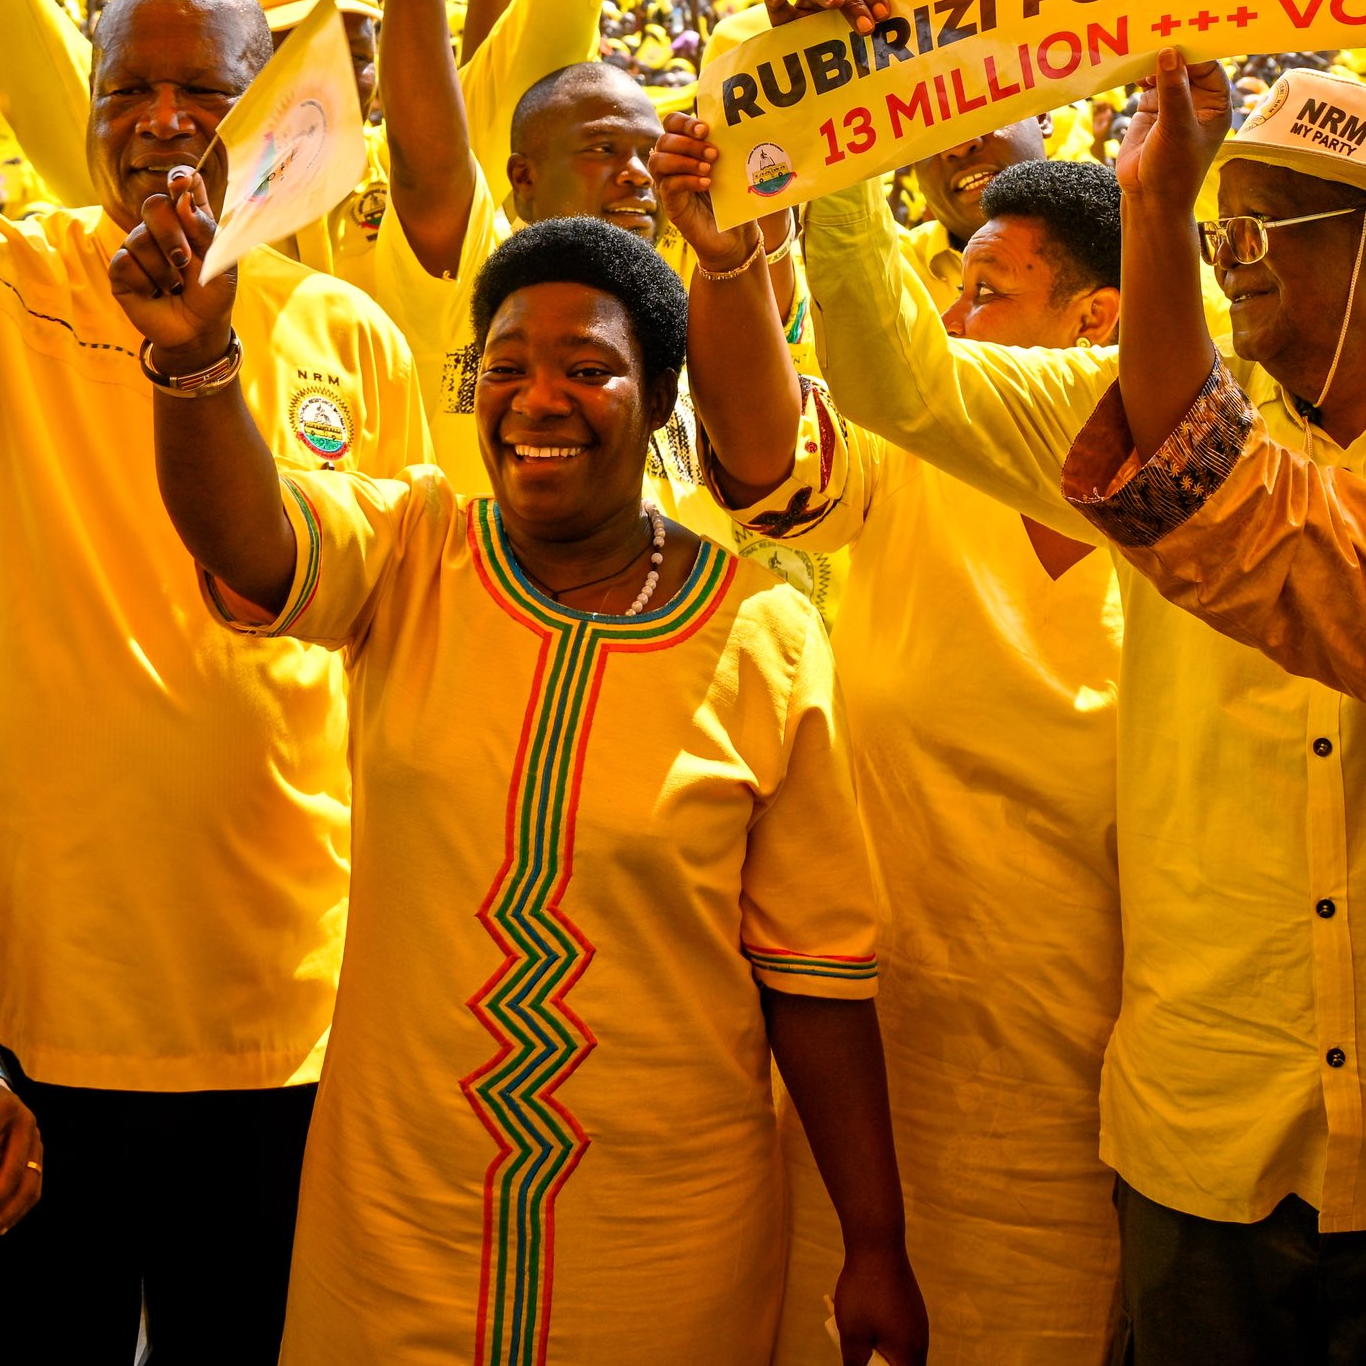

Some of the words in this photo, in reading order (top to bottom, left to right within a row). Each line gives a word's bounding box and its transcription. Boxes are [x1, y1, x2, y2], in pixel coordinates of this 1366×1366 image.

[819, 107, 877, 167] 13
[885, 15, 1130, 139] MILLION
[1290, 122, 1313, 140] MY
[1311, 130, 1357, 157] PARTY
